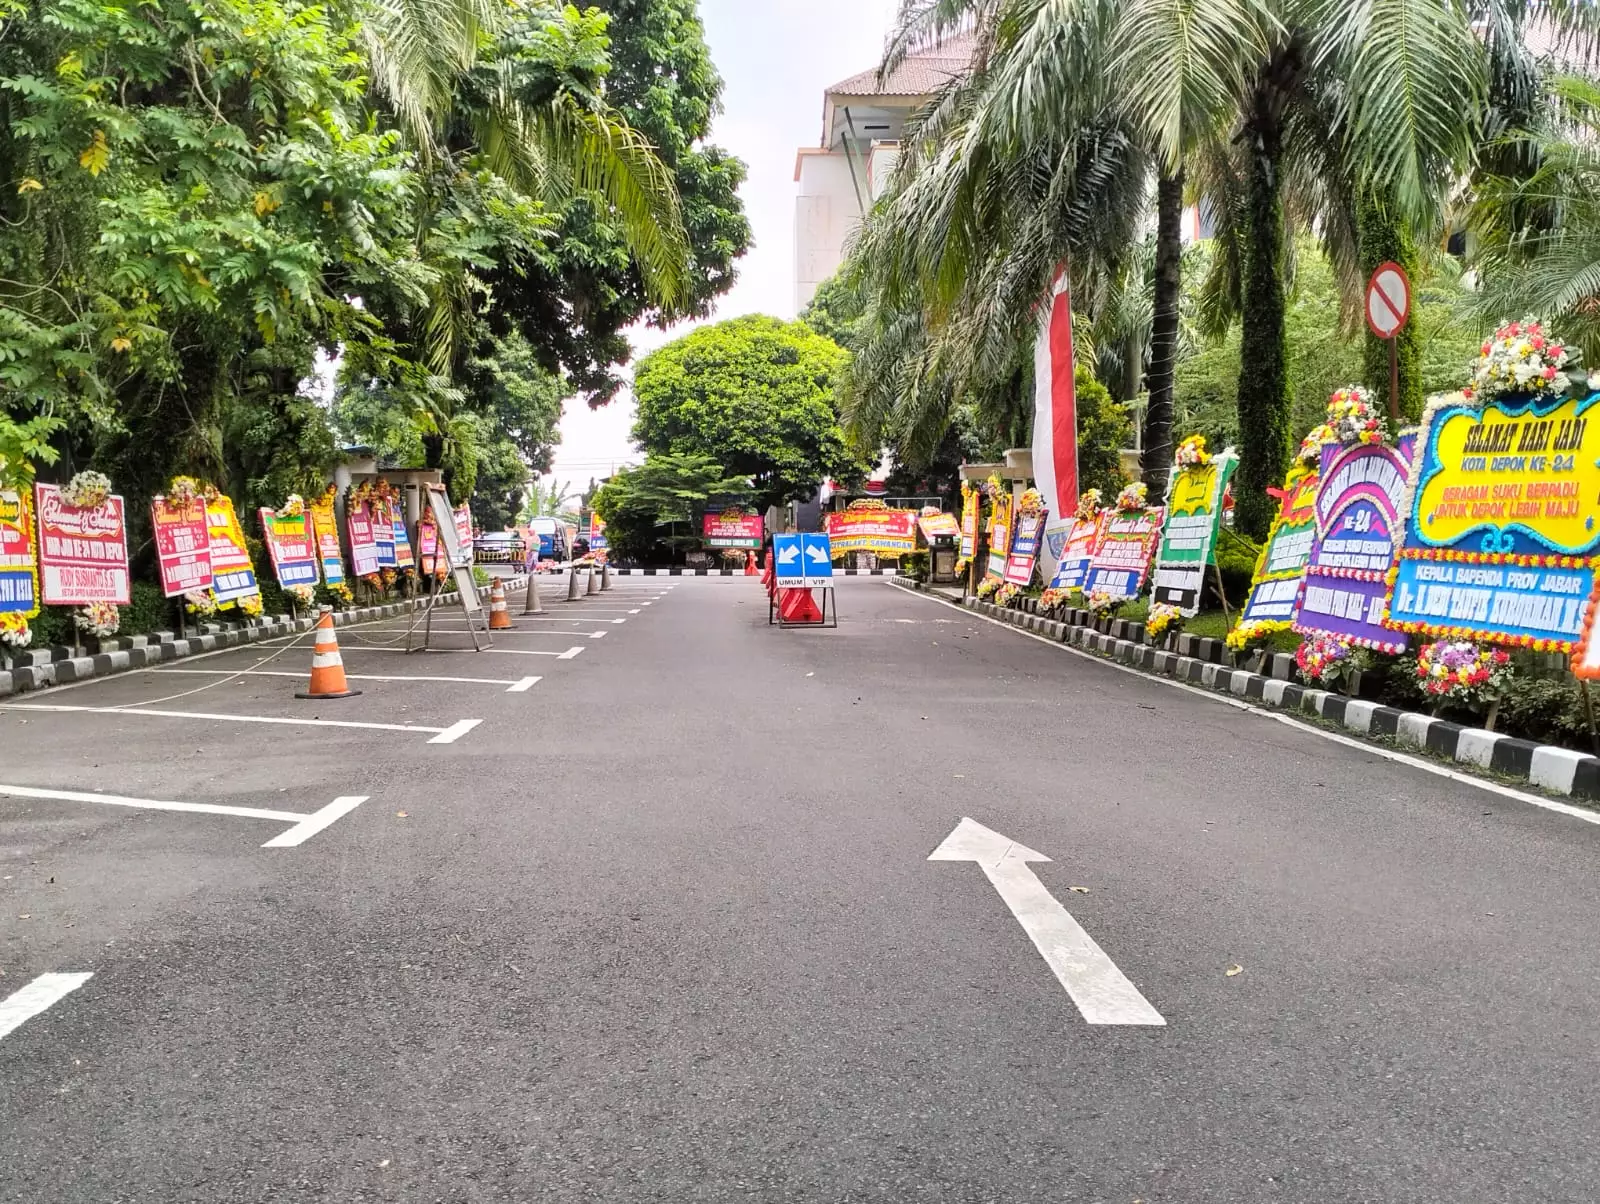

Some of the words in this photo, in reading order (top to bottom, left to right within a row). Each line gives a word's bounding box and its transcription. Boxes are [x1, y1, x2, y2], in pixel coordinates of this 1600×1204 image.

[1463, 423, 1519, 453] SELAMAT
[1517, 420, 1554, 452] HARI
[1553, 418, 1588, 451] JADI
[1461, 457, 1486, 471] KOTA
[1490, 456, 1527, 471] DEPOK
[1443, 485, 1489, 501] BERAGAM
[1492, 484, 1522, 499] SUKU
[1526, 482, 1579, 498] BERPADU
[1435, 503, 1468, 518] UNTUK
[1472, 502, 1507, 518] DEPOK
[1510, 501, 1541, 517] LEBIH
[1545, 500, 1579, 517] MAJU
[1416, 565, 1453, 583] KEPALA
[1456, 567, 1503, 587] BAPENDA
[1506, 572, 1540, 590] PROV
[1540, 574, 1582, 594] JABAR
